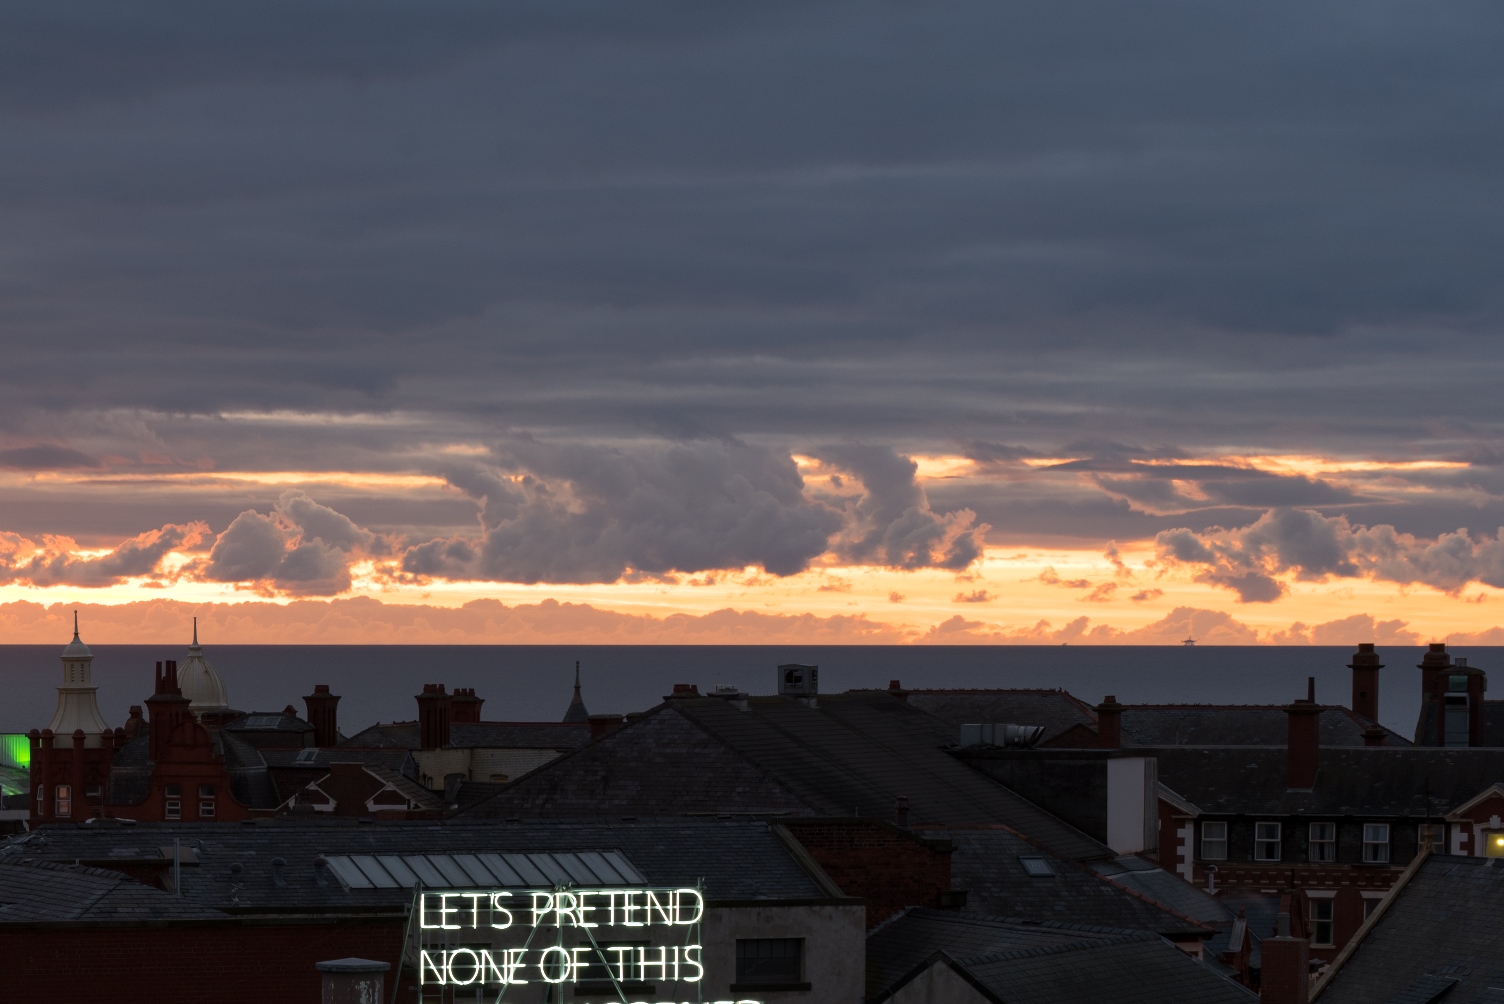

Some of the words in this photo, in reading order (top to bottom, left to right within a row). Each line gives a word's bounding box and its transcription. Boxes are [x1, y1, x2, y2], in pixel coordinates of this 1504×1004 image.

[420, 891, 513, 930] LET'S
[531, 888, 704, 928] PRETEND
[420, 947, 529, 986] NONE
[539, 945, 592, 984] OF
[607, 944, 704, 982] THIS
